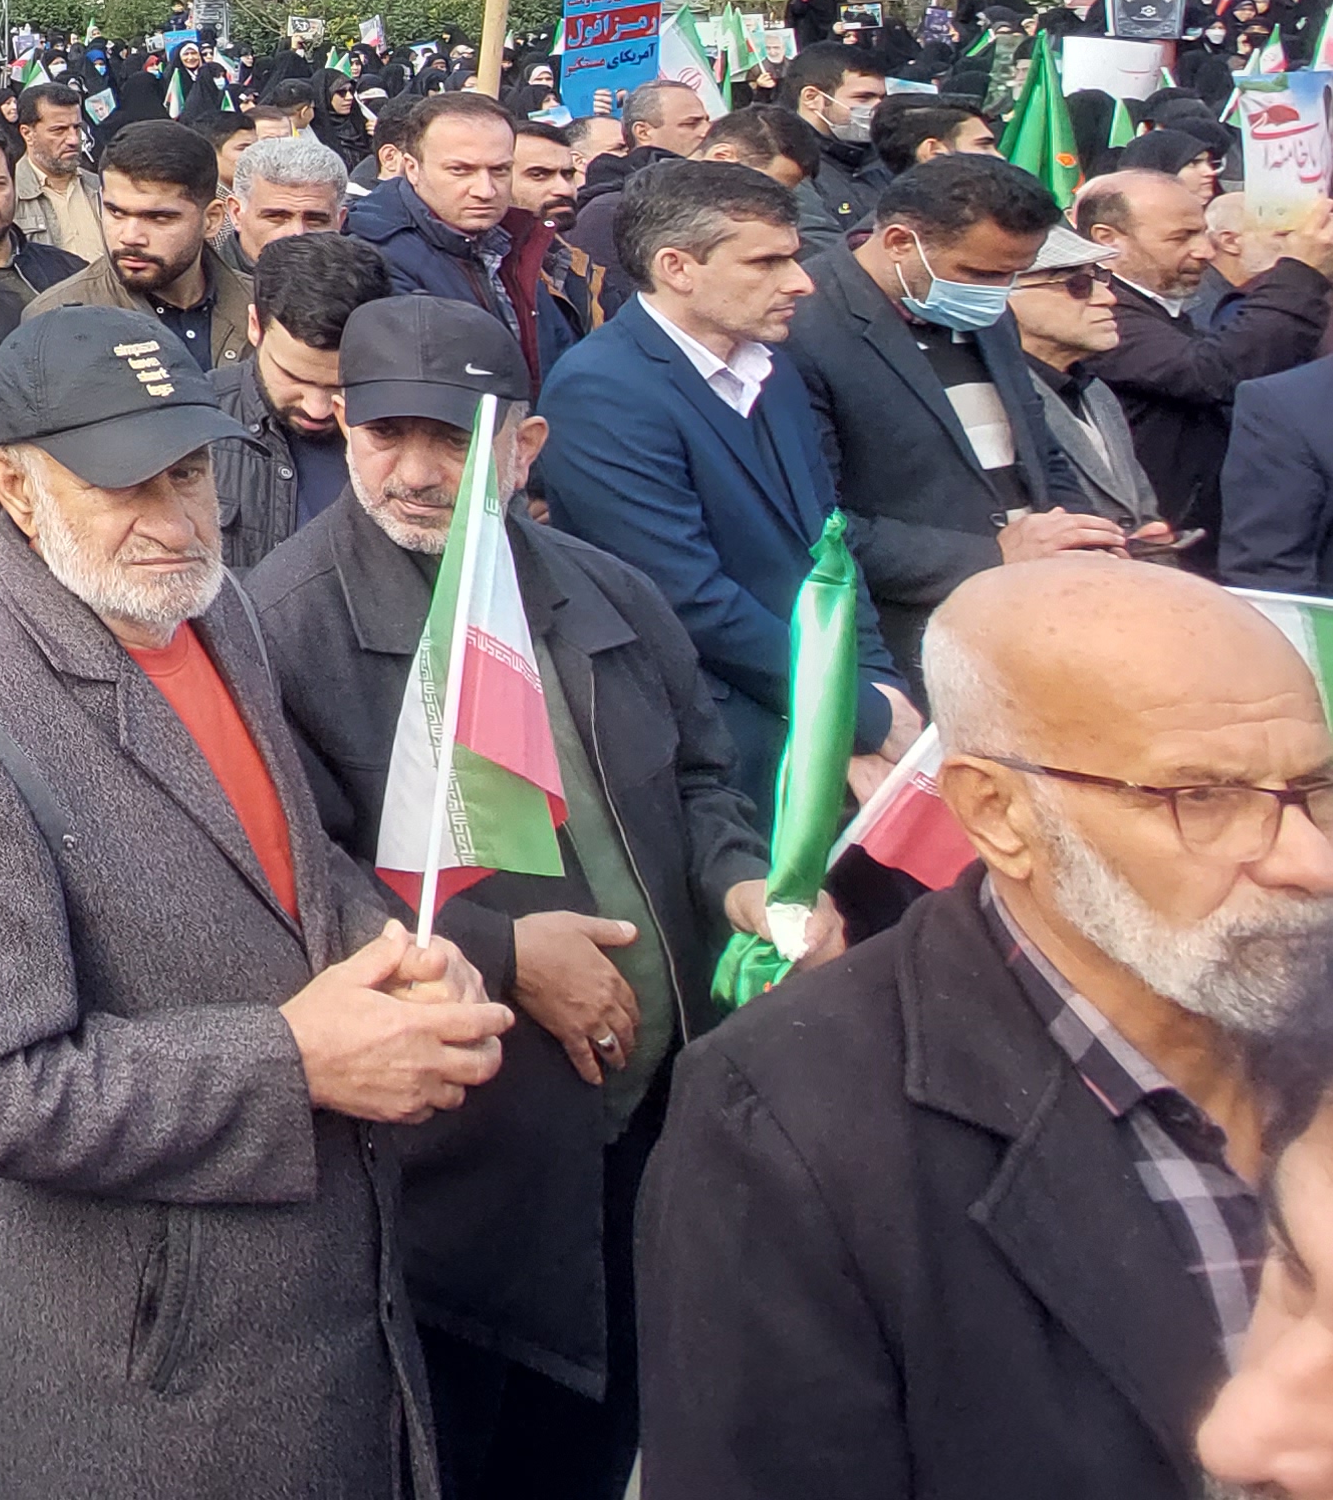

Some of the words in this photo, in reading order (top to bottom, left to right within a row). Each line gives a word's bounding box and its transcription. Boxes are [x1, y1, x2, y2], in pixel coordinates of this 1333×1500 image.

[567, 14, 610, 47] افول
[610, 15, 659, 41] رمز
[564, 56, 606, 78] مستکبر
[606, 42, 657, 70] آمریکای
